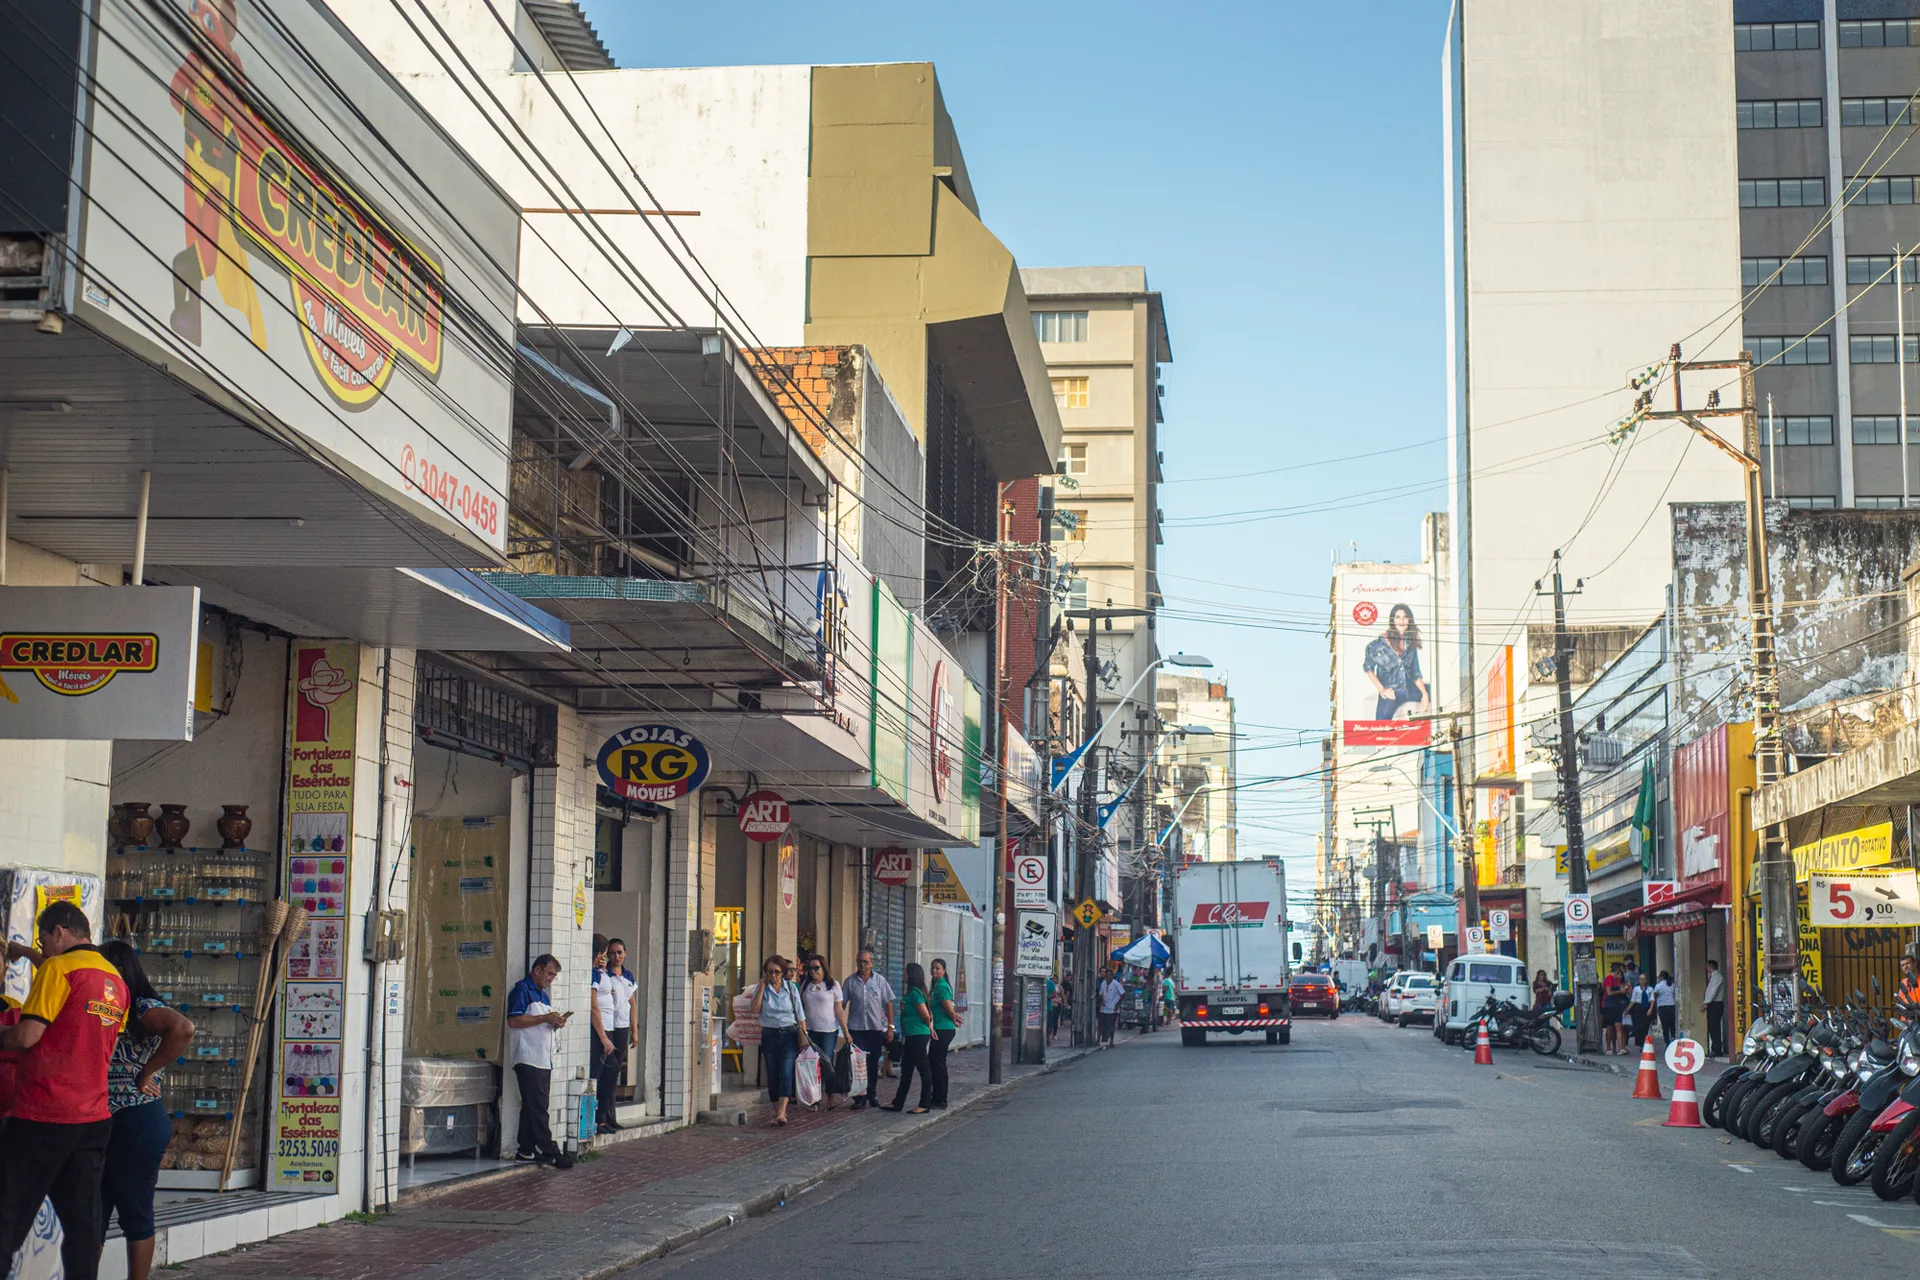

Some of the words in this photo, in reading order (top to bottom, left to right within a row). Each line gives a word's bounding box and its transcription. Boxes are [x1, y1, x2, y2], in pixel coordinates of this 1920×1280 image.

[257, 146, 428, 344] CREDLAR
[419, 458, 497, 535] 3047-0458
[12, 641, 143, 664] CREDLAR
[58, 670, 91, 681] Móveis
[80, 673, 106, 690] comprar
[616, 728, 693, 748] LOJAS
[293, 746, 352, 760] Fortaleza
[310, 760, 333, 773] das
[621, 749, 688, 781] RG
[292, 773, 351, 788] Essências
[293, 790, 321, 800] TUDO
[324, 790, 347, 799] PARA
[627, 784, 676, 801] MÓVEIS
[295, 802, 314, 812] SUA
[317, 802, 345, 811] FESTA
[740, 800, 788, 831] ART
[1861, 836, 1887, 853] ROTATIVO
[875, 854, 909, 879] ART
[1027, 863, 1036, 878] E
[1816, 881, 1826, 889] R$
[934, 892, 957, 901] 4343
[1574, 904, 1582, 917] E
[1496, 914, 1502, 924] E
[1472, 931, 1478, 940] E
[1607, 941, 1626, 951] MAIS
[1020, 954, 1050, 962] Fiscalizada
[1673, 1041, 1695, 1071] 5
[281, 1101, 339, 1113] Fortaleza
[299, 1114, 321, 1126] das
[281, 1126, 339, 1139] Essências
[279, 1140, 338, 1157] 3253.5049
